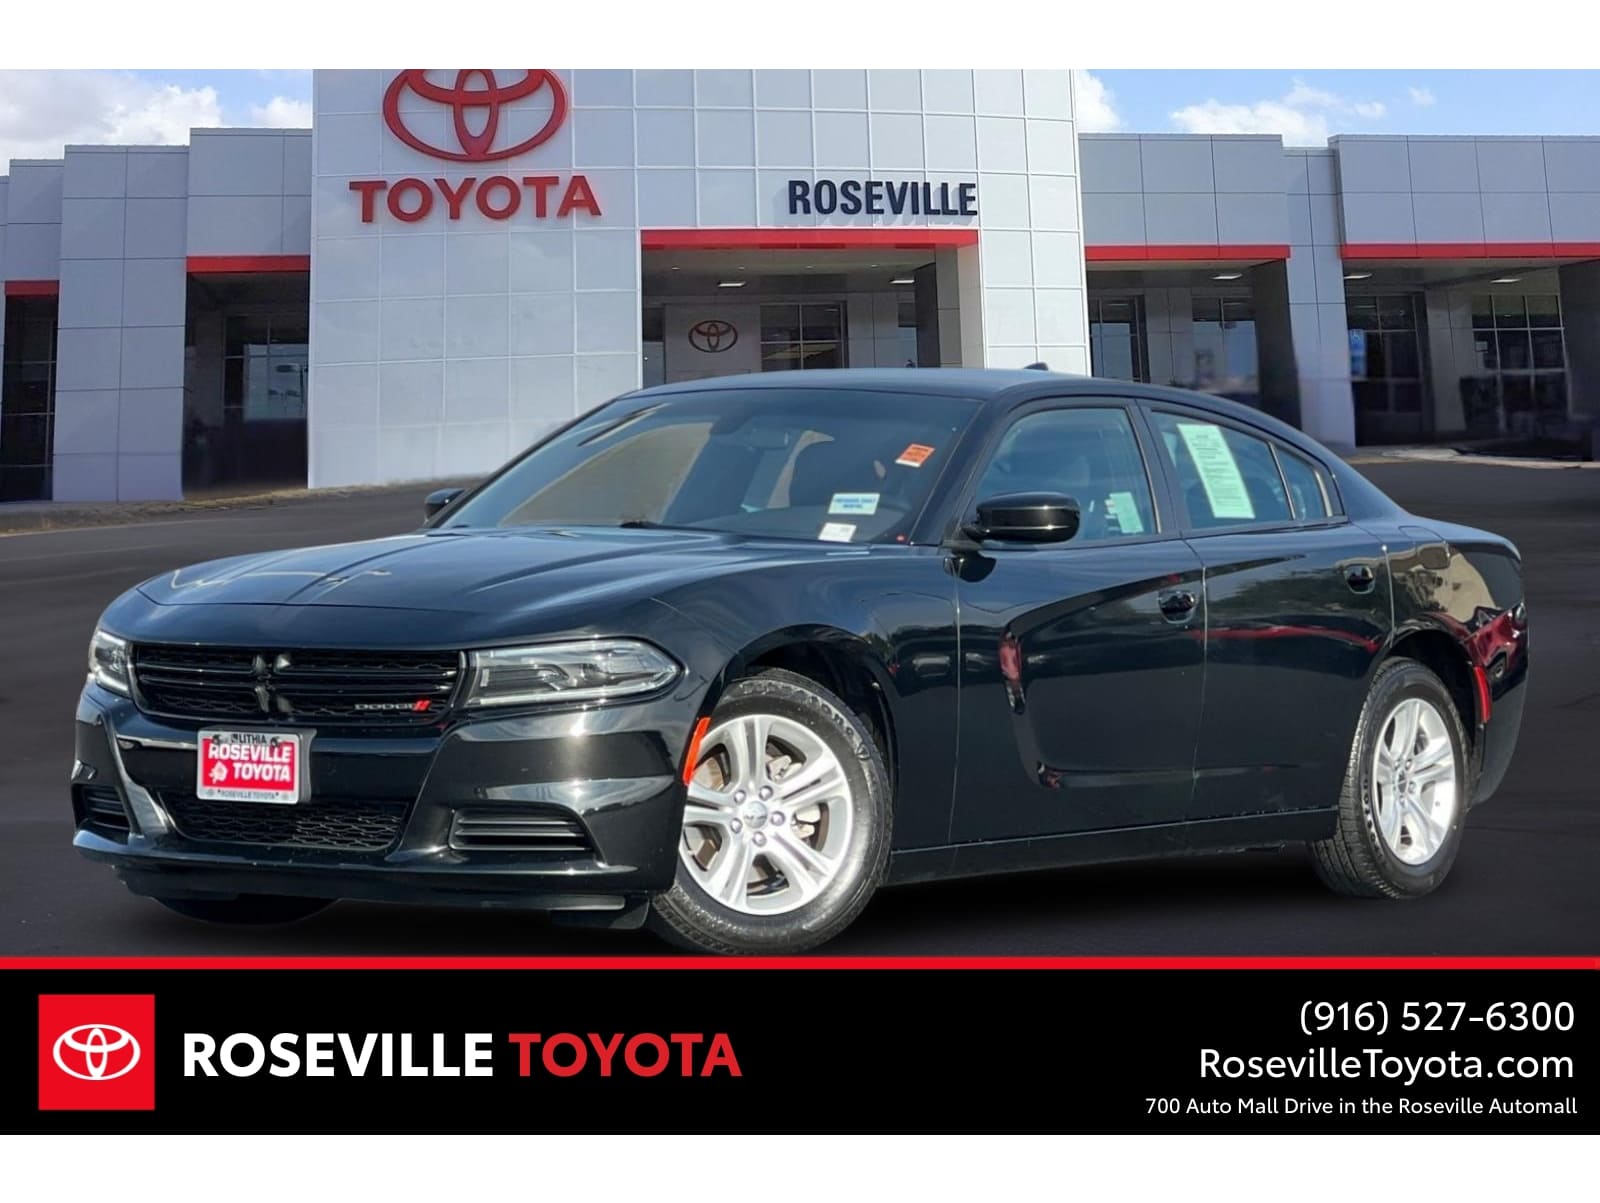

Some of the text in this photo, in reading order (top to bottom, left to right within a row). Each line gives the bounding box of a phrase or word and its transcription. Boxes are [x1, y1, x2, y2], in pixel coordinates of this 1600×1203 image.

[349, 175, 602, 223] TOYOTA
[788, 179, 978, 216] ROSEVILLE
[239, 733, 268, 744] LITHIA
[208, 743, 292, 763] ROSEVILLE
[233, 763, 291, 782] TOYOTA
